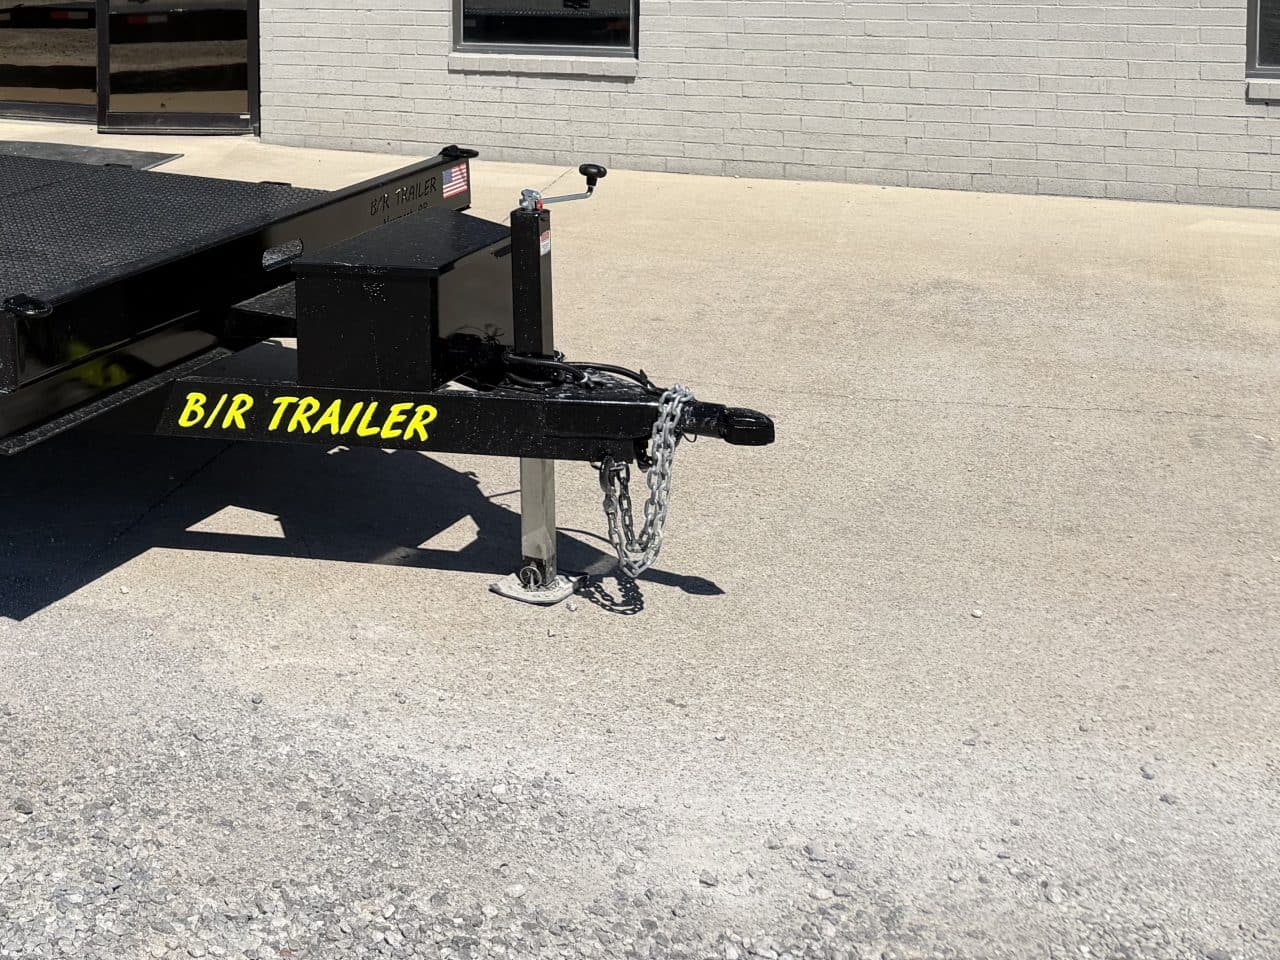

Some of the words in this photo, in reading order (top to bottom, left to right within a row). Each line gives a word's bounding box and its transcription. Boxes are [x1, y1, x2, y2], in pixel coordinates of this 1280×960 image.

[370, 193, 390, 216] B/R
[395, 176, 437, 205] TRAILER
[177, 392, 254, 430] B/R
[268, 396, 438, 442] TRAILER
